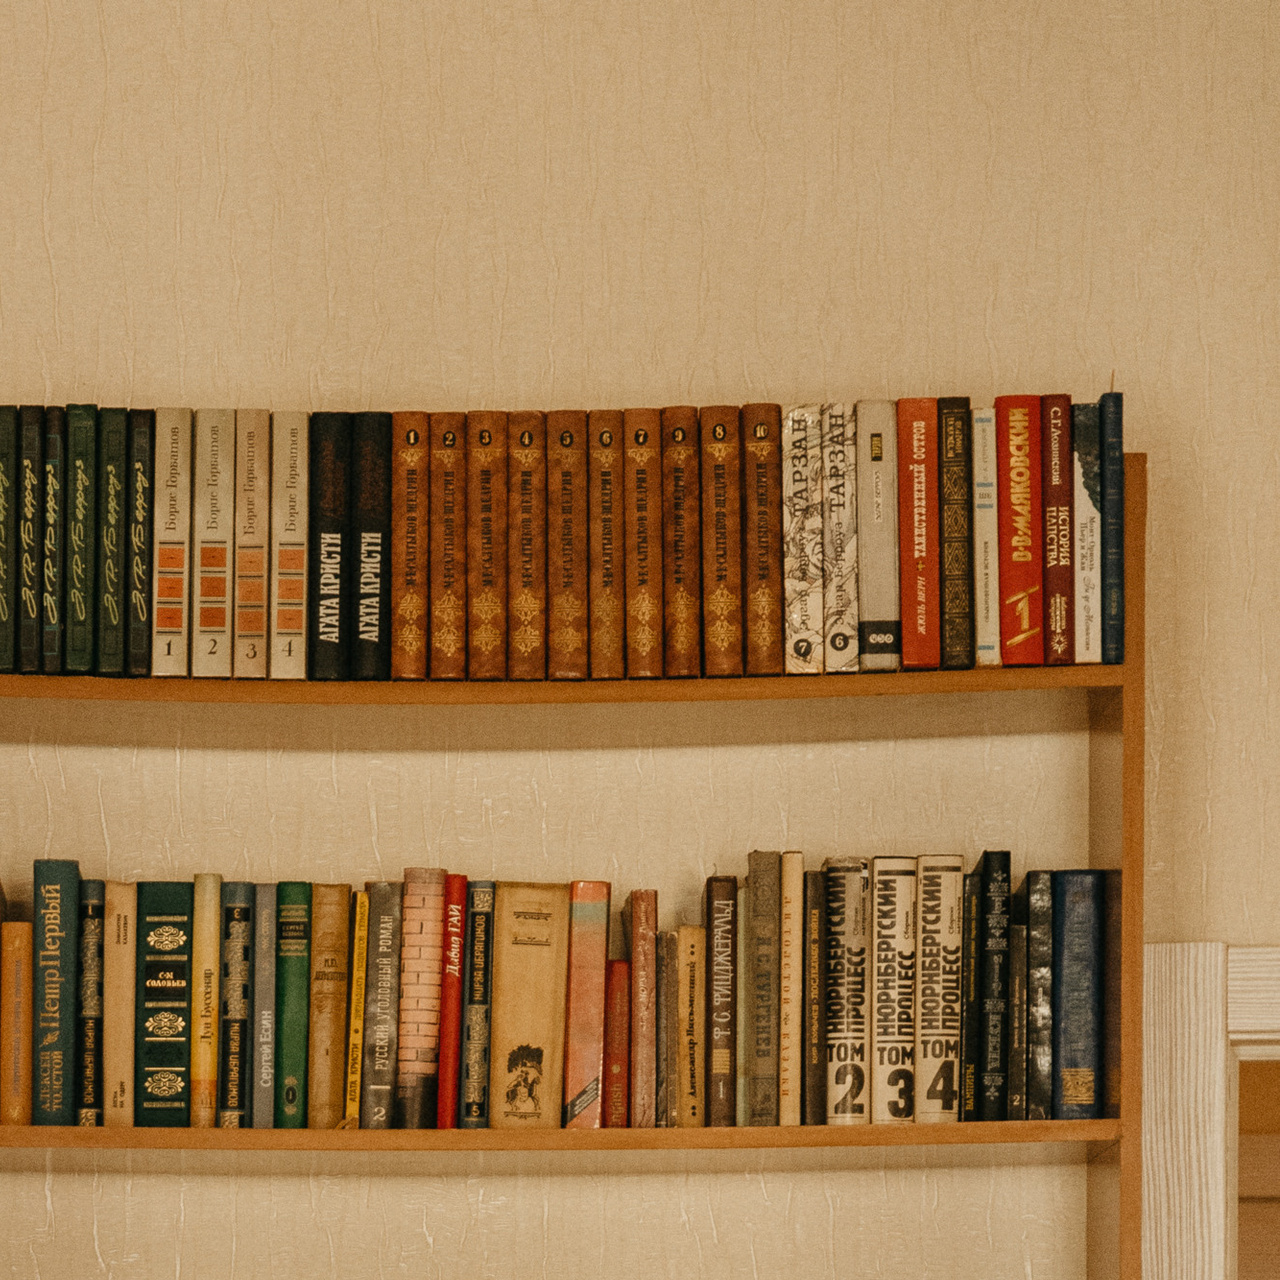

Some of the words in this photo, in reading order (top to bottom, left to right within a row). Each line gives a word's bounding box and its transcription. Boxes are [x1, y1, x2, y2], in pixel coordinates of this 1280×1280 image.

[165, 426, 180, 489] Горбатов
[285, 427, 299, 489] Горбатов
[830, 412, 845, 508] ТАРЗАН
[914, 420, 925, 459] ОСТРОВ
[794, 420, 808, 515] ТАРЗАН
[1046, 507, 1056, 568] ПАПСТВА
[1058, 508, 1070, 566] ИСТОРИЯ
[319, 532, 341, 593] КРИСТИ
[360, 532, 382, 593] КРИСТИ
[318, 596, 340, 643] АГАТА
[359, 596, 380, 642] АГАТА
[835, 636, 844, 647] 6
[164, 639, 173, 656] 1
[282, 640, 295, 657] 4
[799, 643, 808, 654] 7
[379, 915, 392, 951] РОМАН
[448, 904, 462, 932] ГАЙ
[448, 936, 462, 976] Давид
[714, 900, 734, 1003] ФИЦДЖЕРАЛЬД
[827, 875, 845, 1034] НЮРНБЕРГСКИЙ
[377, 958, 392, 1019] УГОЛОВНЫЙ
[847, 946, 864, 1032] ПРОЦЕСС
[942, 945, 960, 1029] ПРОЦЕСС
[261, 1010, 272, 1041] Есин
[375, 1026, 392, 1069] РУССКИЙ
[922, 1040, 959, 1058] ТОМ
[261, 1044, 272, 1088] Сергей
[828, 1043, 865, 1063] ТОМ
[835, 1064, 864, 1114] 2
[926, 1061, 958, 1110] 4
